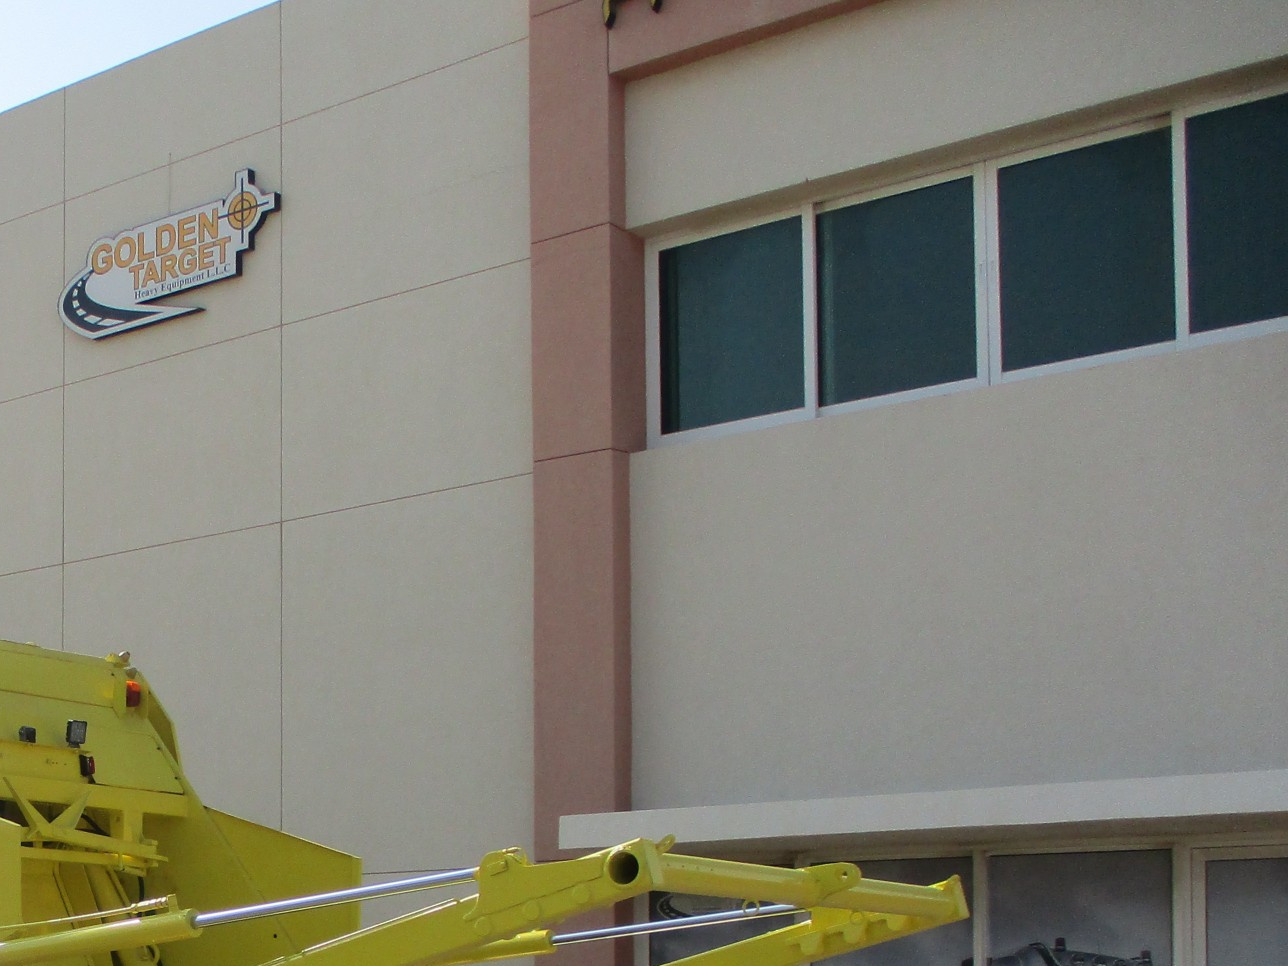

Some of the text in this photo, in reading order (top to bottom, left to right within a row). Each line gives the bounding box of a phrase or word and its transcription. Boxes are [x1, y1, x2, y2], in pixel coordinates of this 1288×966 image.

[91, 207, 219, 275] GOLDEN
[128, 236, 232, 291] TARGET
[134, 286, 159, 300] Heavy
[161, 272, 204, 292] Equipment
